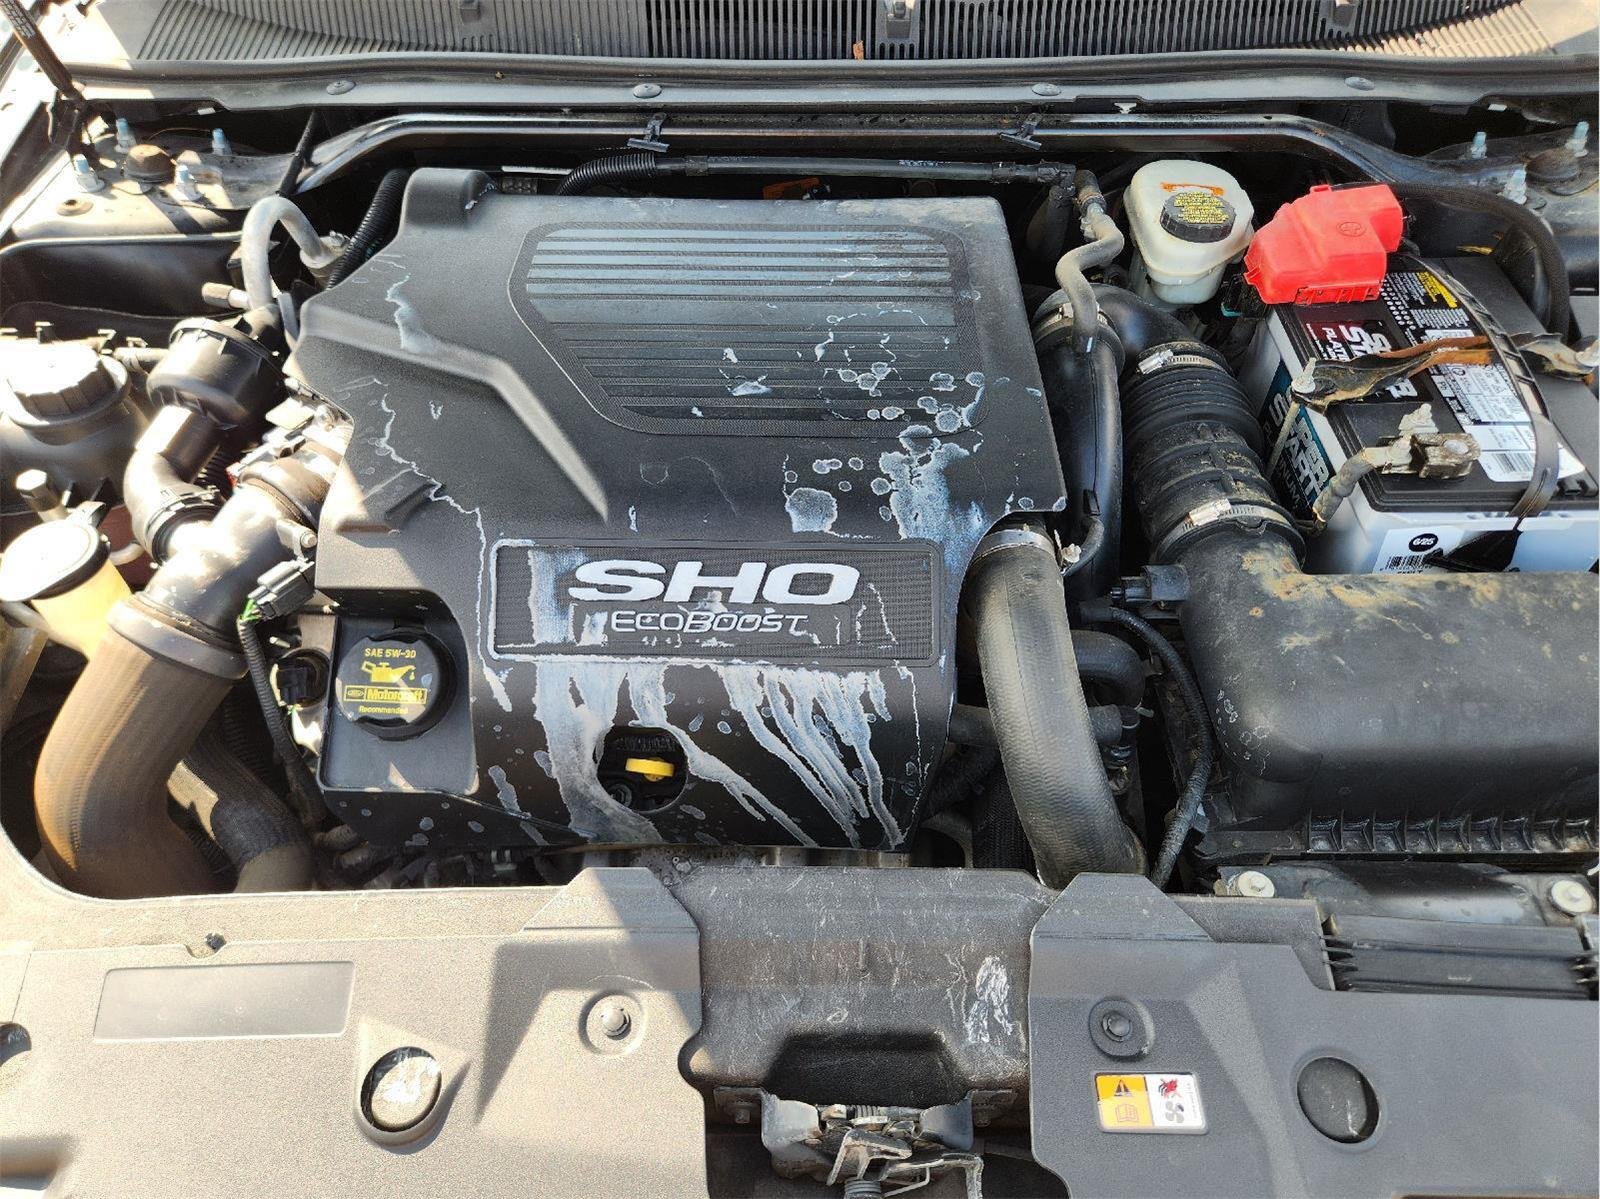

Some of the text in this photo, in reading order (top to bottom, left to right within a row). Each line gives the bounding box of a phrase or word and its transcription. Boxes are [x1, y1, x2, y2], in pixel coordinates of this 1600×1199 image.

[1271, 393, 1323, 501] SART
[567, 559, 860, 605] SHO
[364, 648, 417, 659] SAE 5W-30
[359, 705, 409, 715] Recommended
